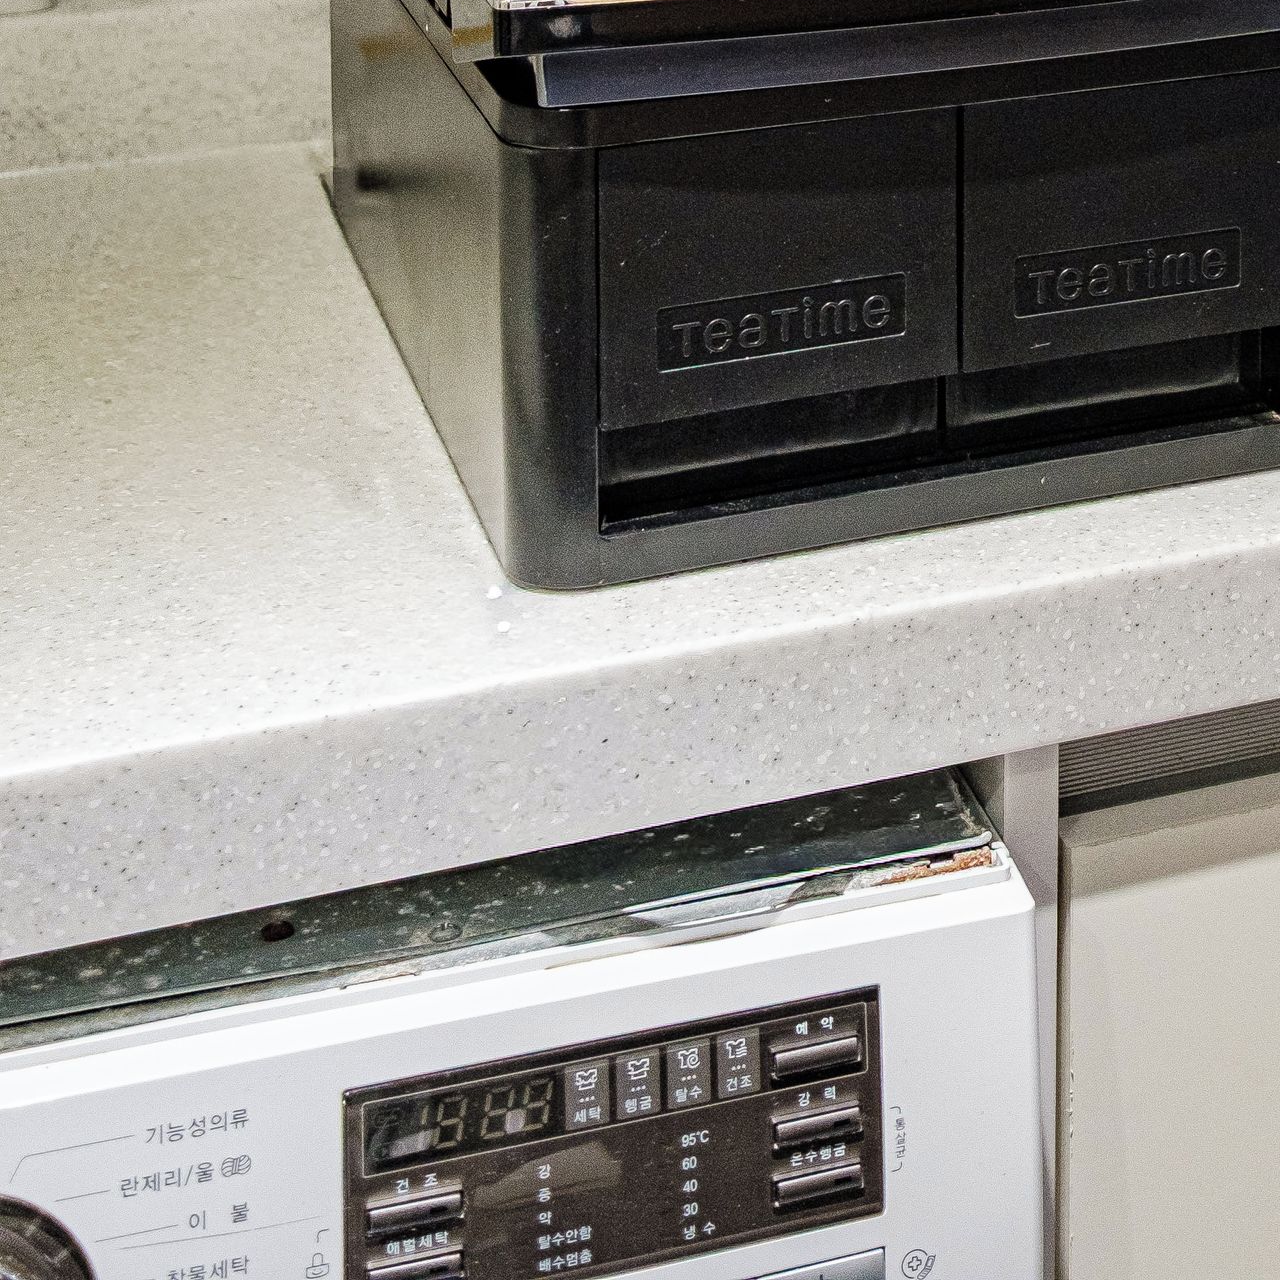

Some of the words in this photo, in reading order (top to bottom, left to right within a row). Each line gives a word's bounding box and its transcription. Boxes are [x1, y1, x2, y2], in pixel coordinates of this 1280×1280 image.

[726, 1074, 753, 1092] 건조
[675, 1085, 703, 1103] 탈수
[573, 1105, 602, 1123] 세탁
[145, 1108, 250, 1145] 기능성의류
[537, 1163, 551, 1179] 강
[682, 1156, 697, 1170] 60
[120, 1161, 215, 1198] 란제리/울
[683, 1179, 698, 1193] 40
[537, 1187, 551, 1202] 중
[538, 1210, 552, 1225] 약
[683, 1202, 699, 1217] 30
[386, 1230, 449, 1255] 애벌세탁
[537, 1225, 593, 1251] 탈수안함
